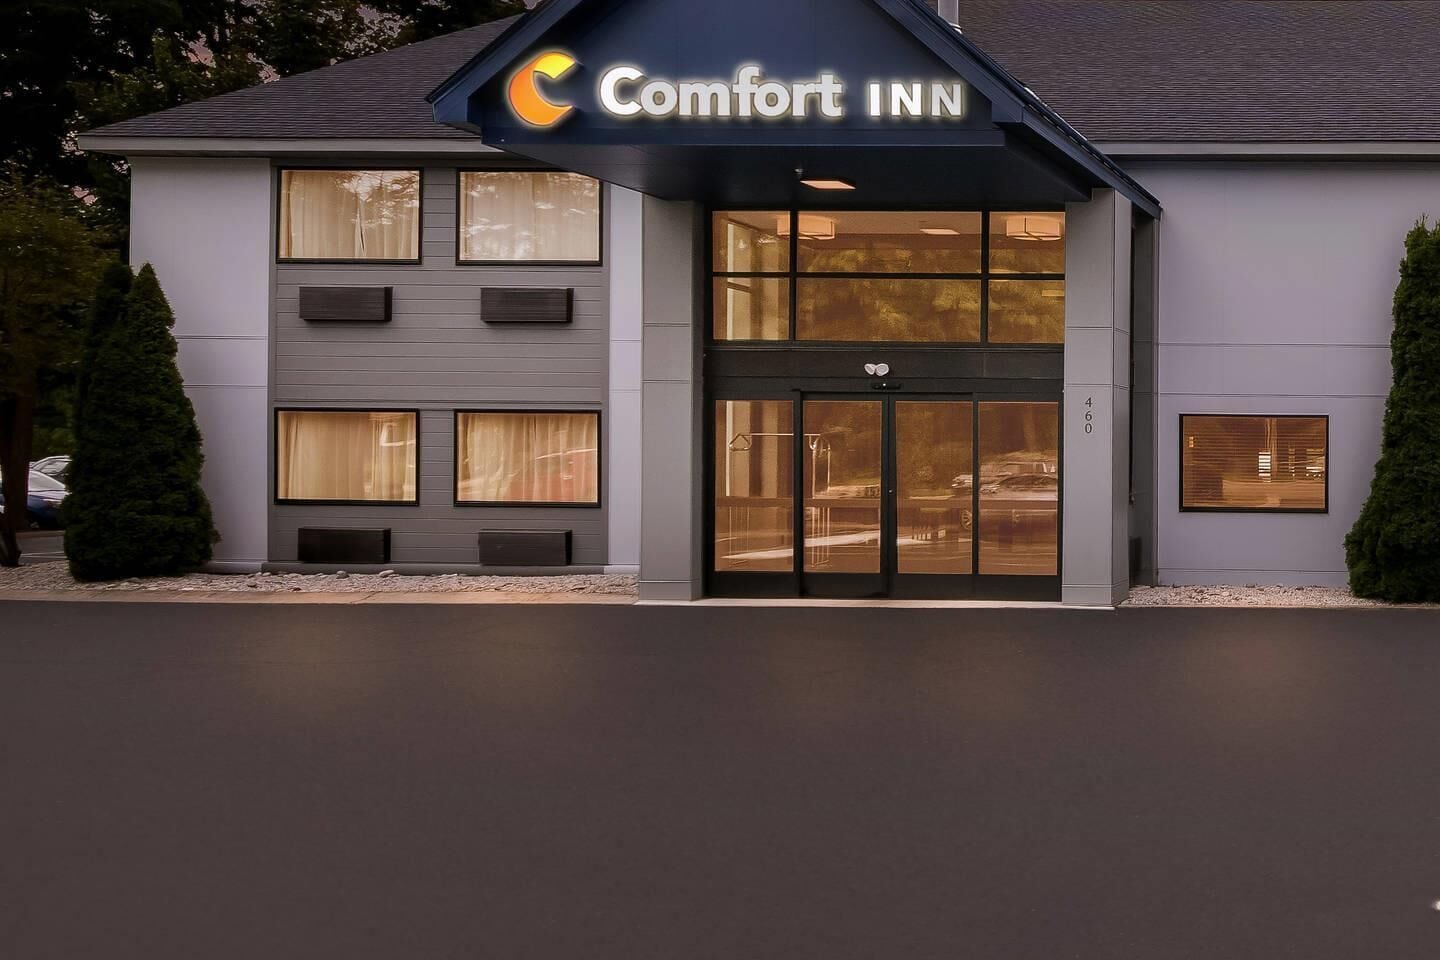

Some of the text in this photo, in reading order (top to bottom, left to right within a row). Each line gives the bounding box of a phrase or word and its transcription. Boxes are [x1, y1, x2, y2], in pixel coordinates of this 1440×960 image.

[599, 65, 843, 117] Comfort
[868, 82, 962, 117] INN
[1084, 397, 1093, 434] 460
